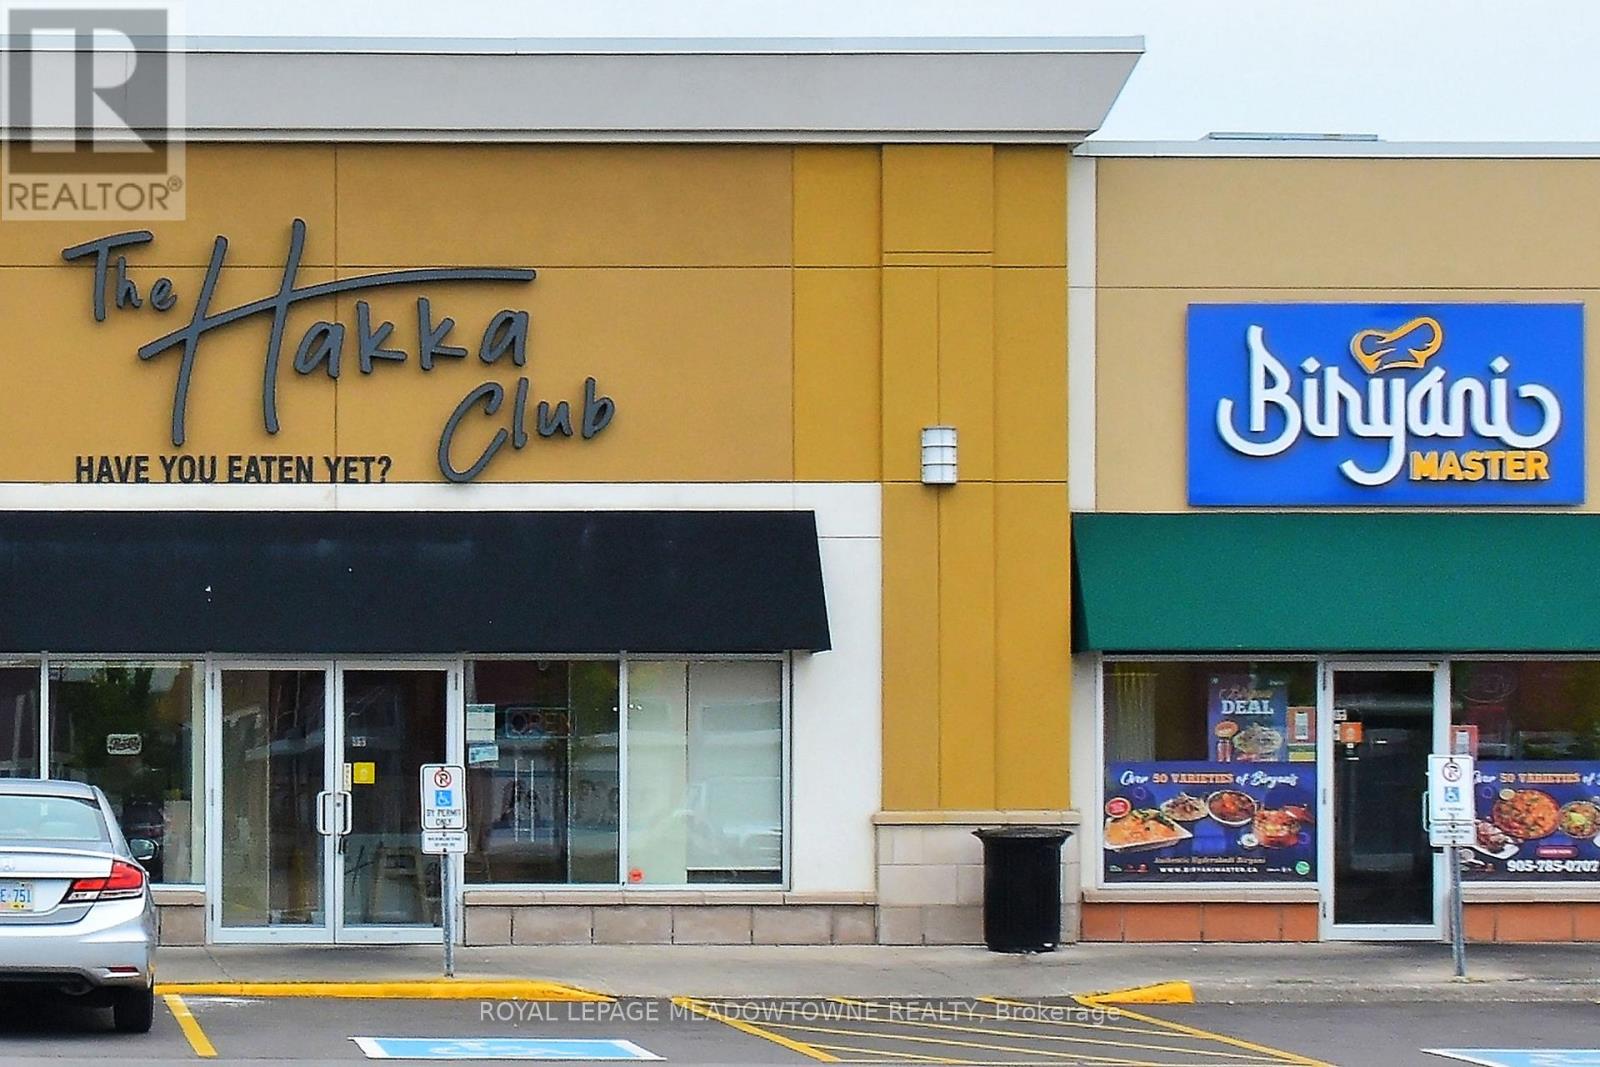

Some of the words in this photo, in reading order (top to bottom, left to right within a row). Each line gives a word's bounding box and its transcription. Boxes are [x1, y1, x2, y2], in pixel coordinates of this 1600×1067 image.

[61, 230, 177, 322] The
[138, 218, 536, 447] Hakka
[1216, 325, 1562, 487] Biryani
[438, 376, 616, 484] Club
[75, 455, 150, 484] HAVE
[159, 455, 217, 484] YOU
[227, 455, 313, 484] EATEN
[323, 455, 393, 484] YET?
[1409, 450, 1549, 481] MASTER
[1221, 700, 1274, 714] DEAL
[1120, 771, 1148, 786] Over
[1152, 773, 1168, 784] 50
[1171, 773, 1234, 784] VARIETIES
[1236, 773, 1249, 786] of
[1499, 772, 1516, 783] 50
[1506, 860, 1600, 872] 905-785-0707
[13, 888, 31, 904] 751
